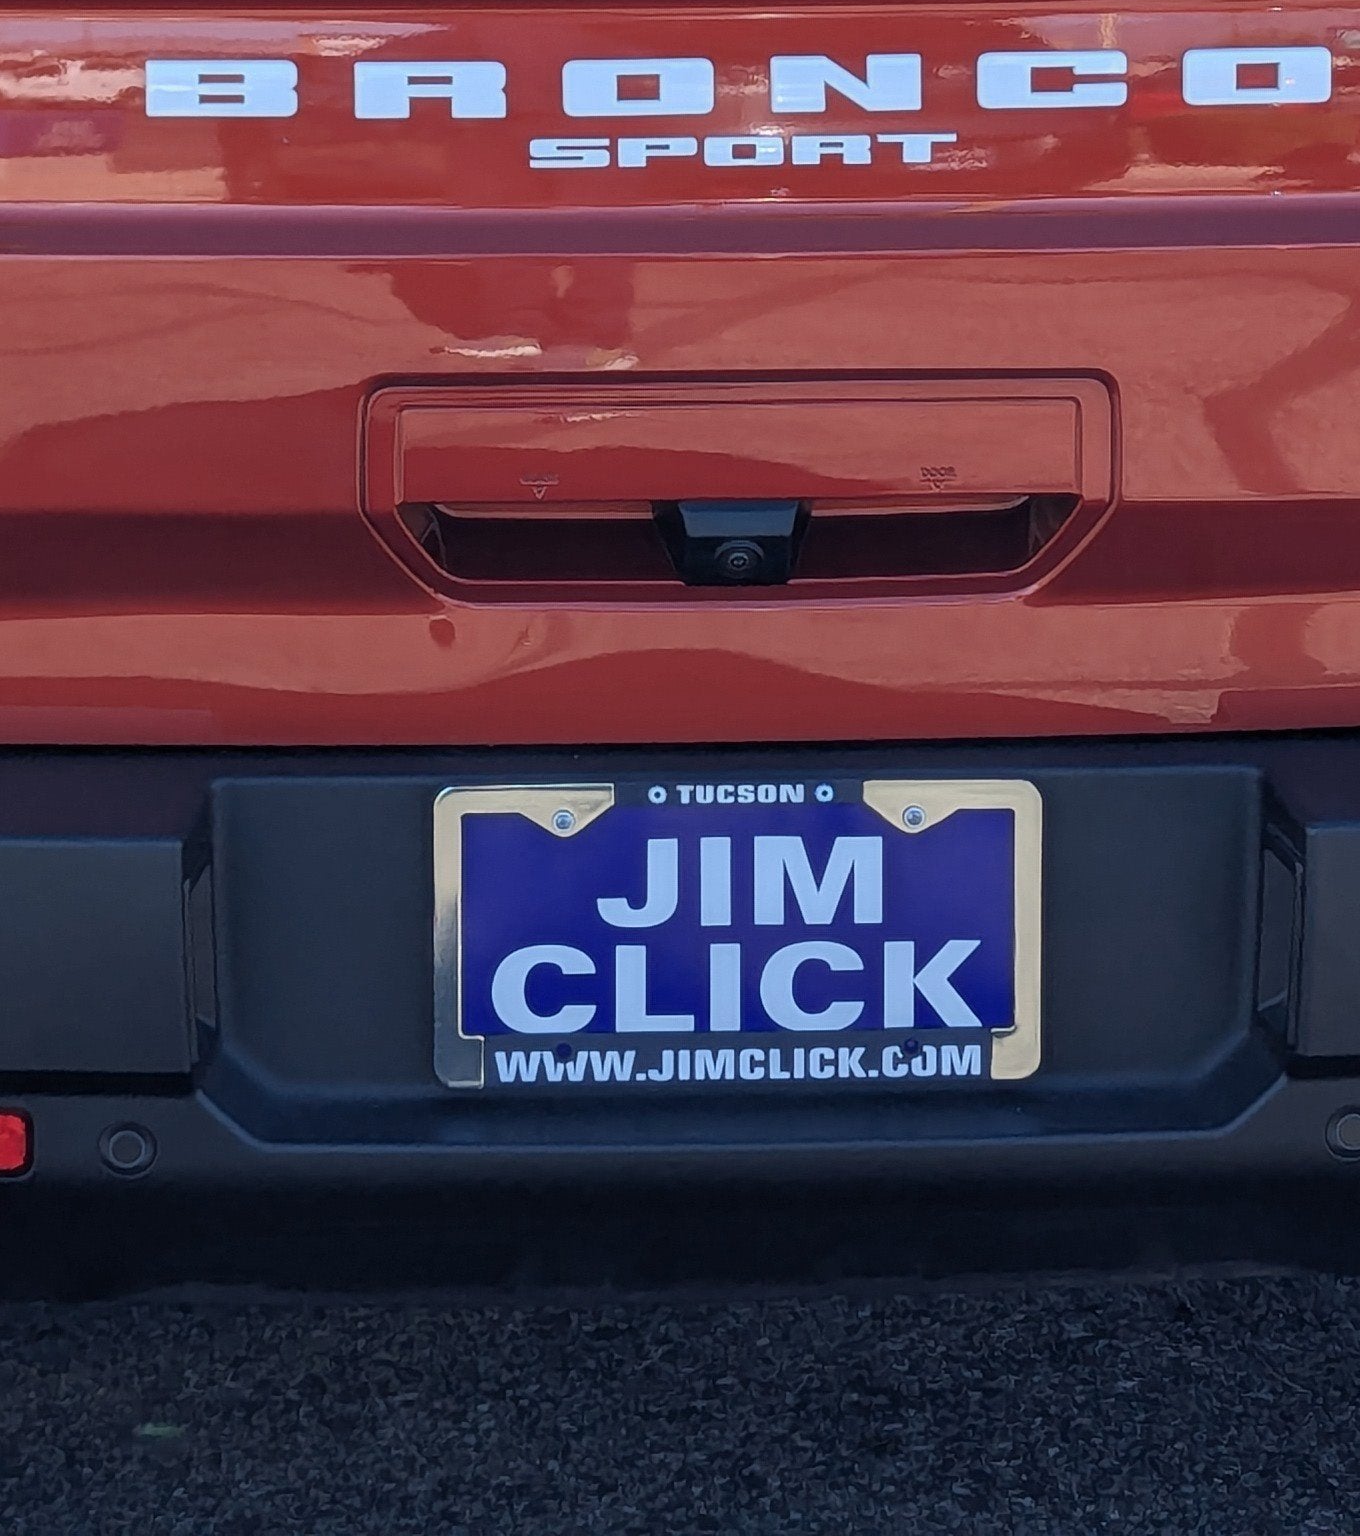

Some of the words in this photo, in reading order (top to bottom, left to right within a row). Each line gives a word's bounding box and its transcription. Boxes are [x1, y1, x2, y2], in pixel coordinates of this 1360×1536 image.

[145, 46, 1332, 120] BRONCO
[528, 132, 958, 169] SPORT
[675, 784, 805, 804] TUCSON
[596, 835, 883, 928] JIM
[490, 939, 983, 1034] CLICK
[494, 1044, 982, 1083] WWW.JIMCLICK.COM
